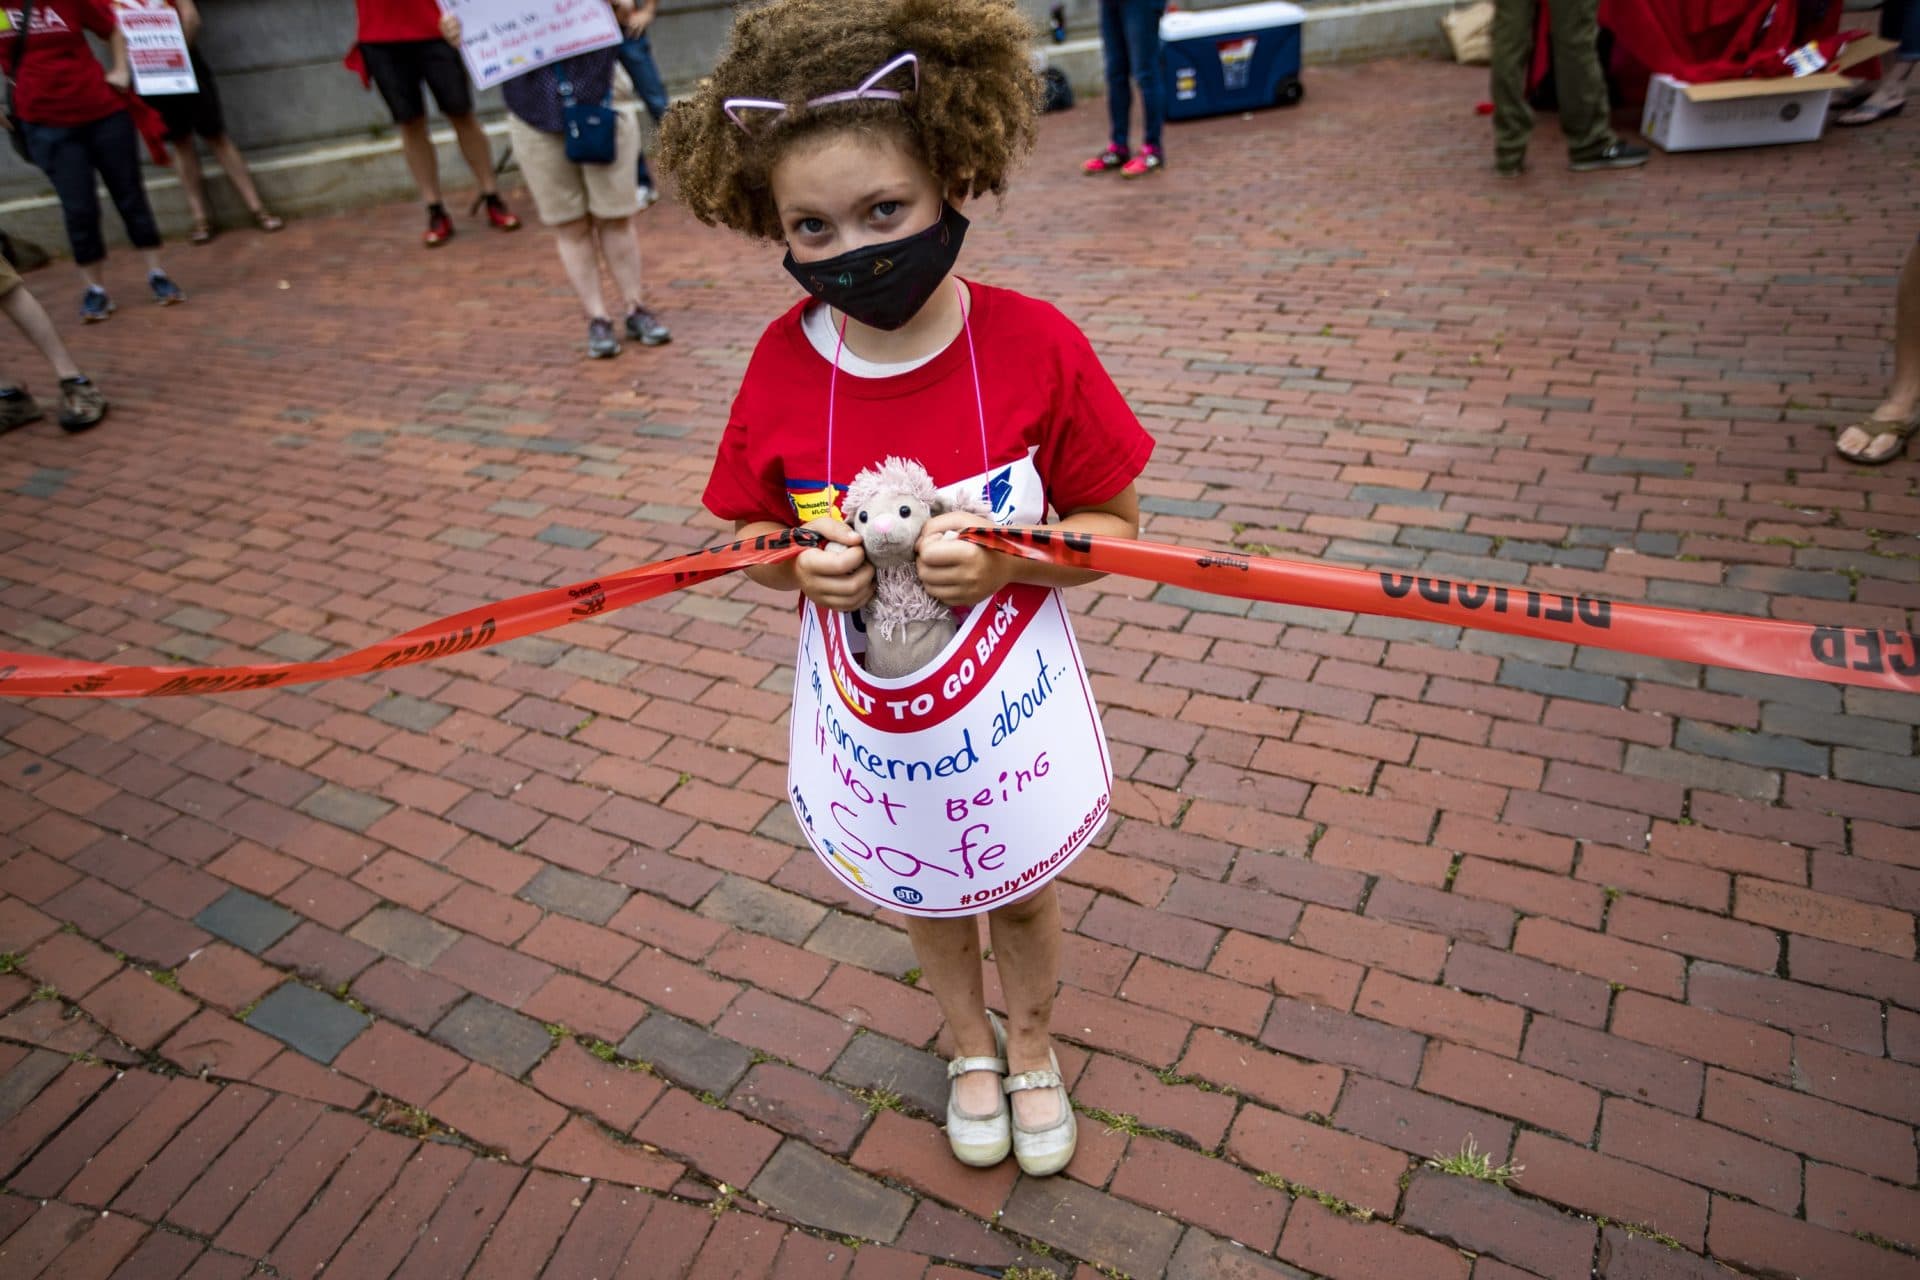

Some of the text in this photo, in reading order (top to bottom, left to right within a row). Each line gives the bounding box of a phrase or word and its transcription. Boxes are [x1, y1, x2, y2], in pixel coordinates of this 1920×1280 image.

[833, 640, 876, 714] WANT
[886, 693, 934, 720] TO
[943, 658, 975, 700] GO
[975, 594, 1019, 667] BACK
[826, 703, 979, 782] concerned
[960, 794, 1108, 905] #OnlyWhenItsSafe
